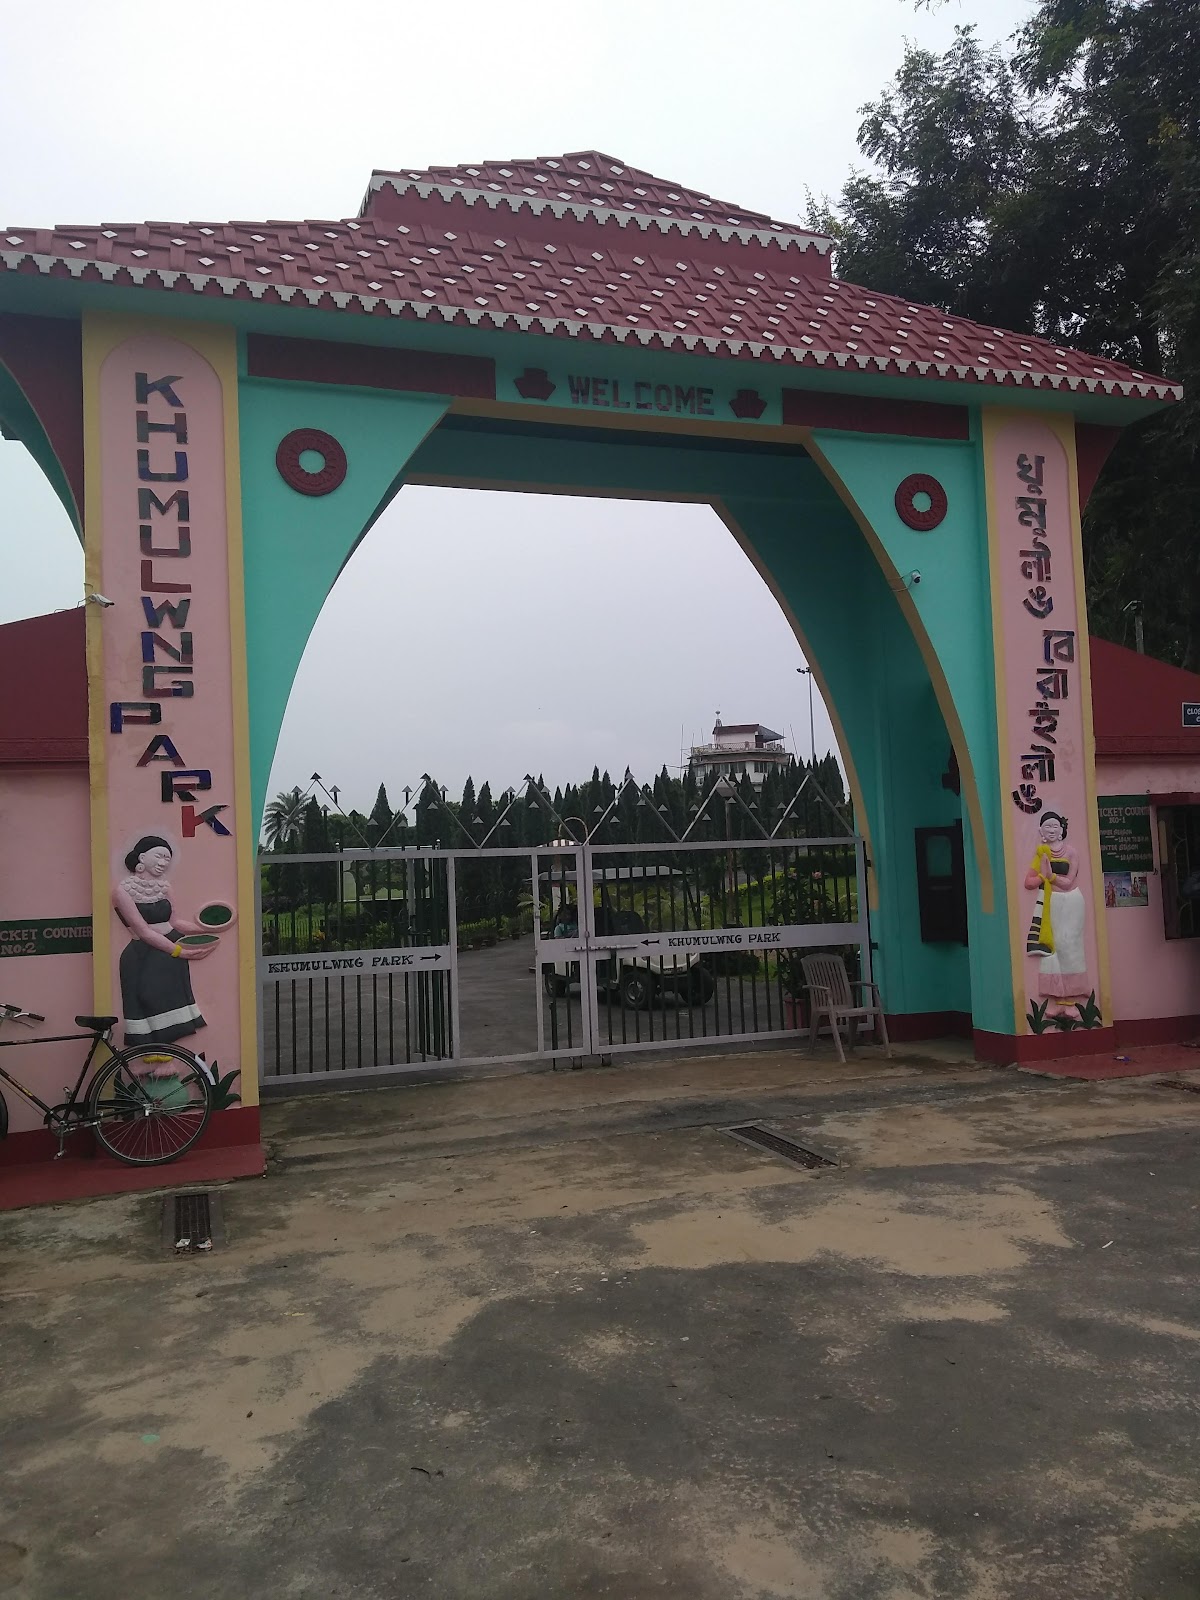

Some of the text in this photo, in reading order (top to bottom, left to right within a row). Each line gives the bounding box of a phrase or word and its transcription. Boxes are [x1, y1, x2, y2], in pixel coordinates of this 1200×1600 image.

[567, 374, 715, 416] WELCOME
[110, 372, 233, 838] KHUMULWNG PARK
[1098, 807, 1123, 817] ICKET
[43, 925, 93, 939] COUNTER
[668, 932, 781, 947] KHUMULWNG PARK
[268, 954, 414, 974] KHUMULWNG PARK
